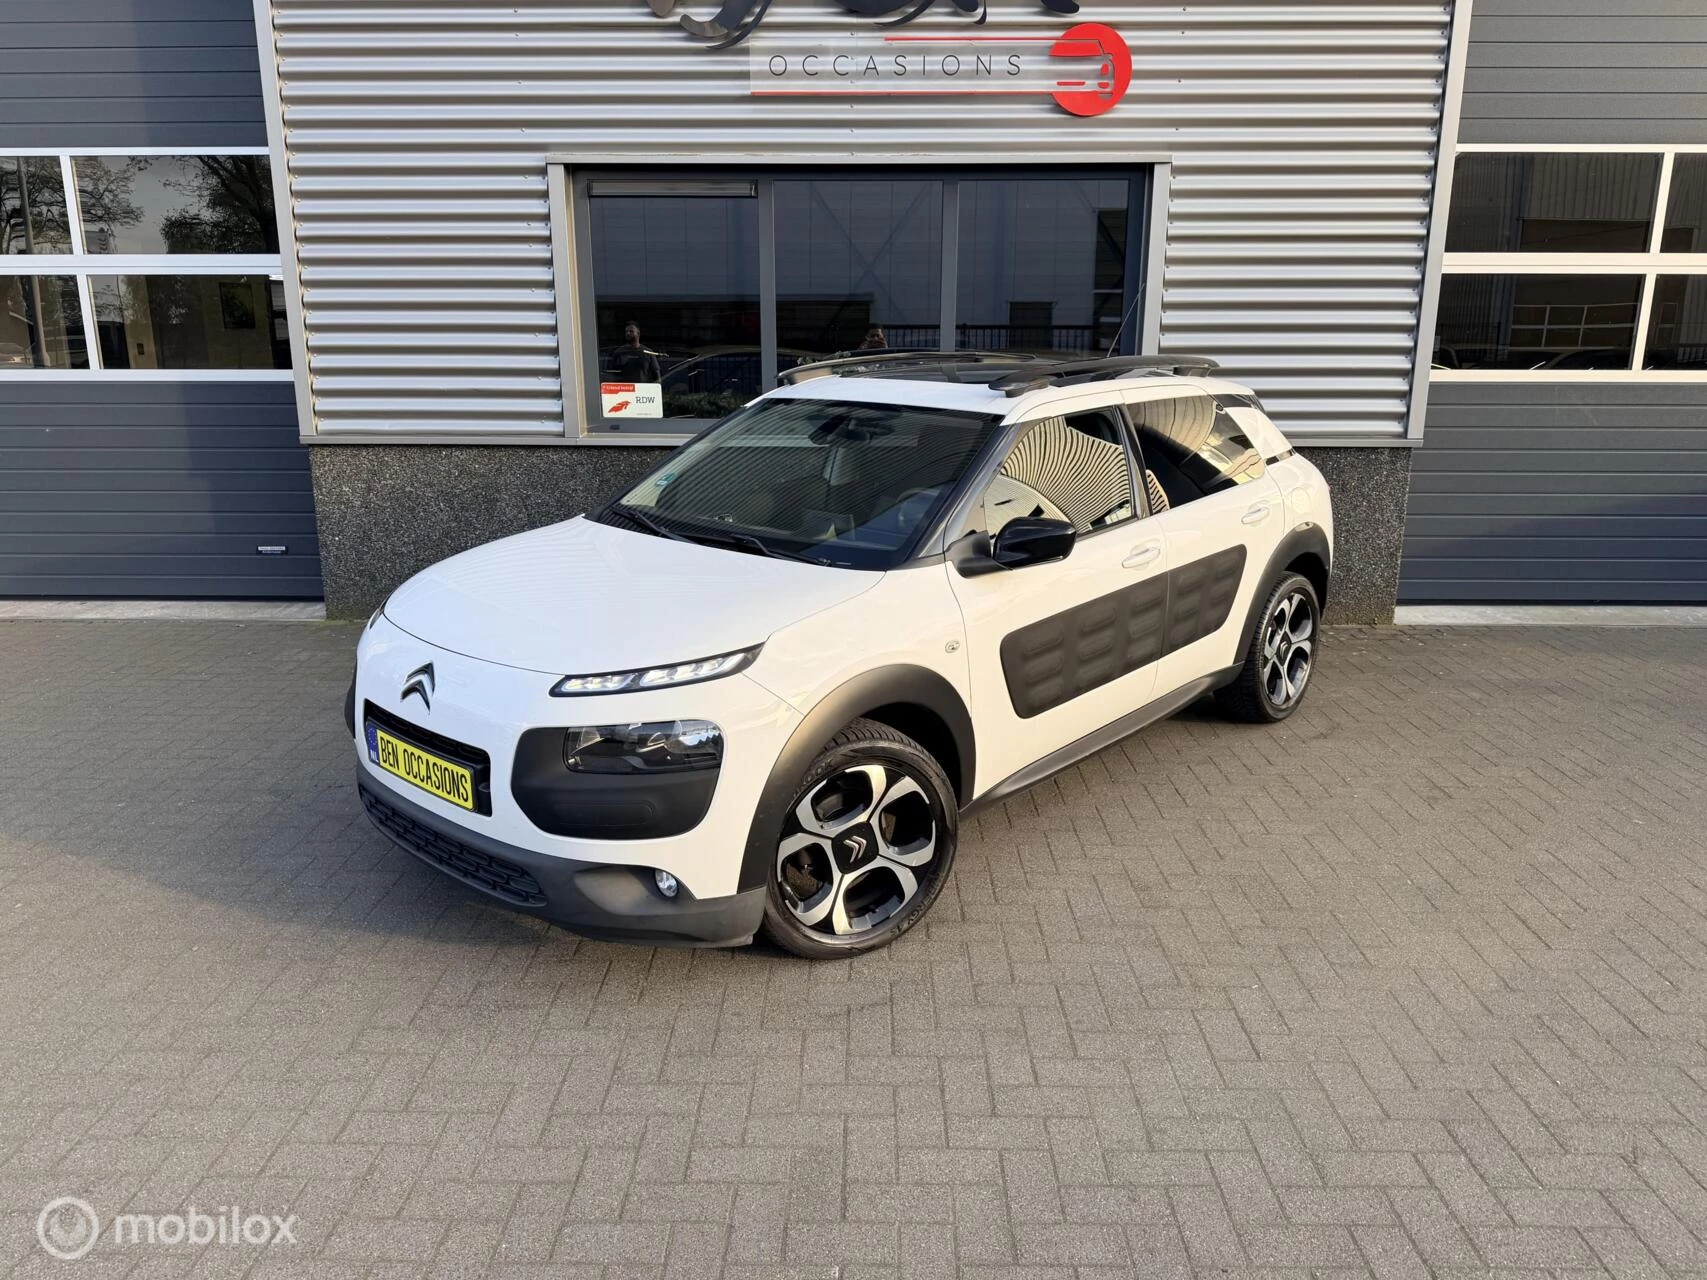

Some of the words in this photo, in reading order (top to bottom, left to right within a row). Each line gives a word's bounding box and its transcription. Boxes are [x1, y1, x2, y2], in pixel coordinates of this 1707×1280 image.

[768, 54, 1023, 77] OCCASIONS
[635, 396, 656, 404] RDW
[370, 749, 379, 763] NL
[380, 736, 400, 771] BEN
[403, 748, 469, 803] OCCASIONS
